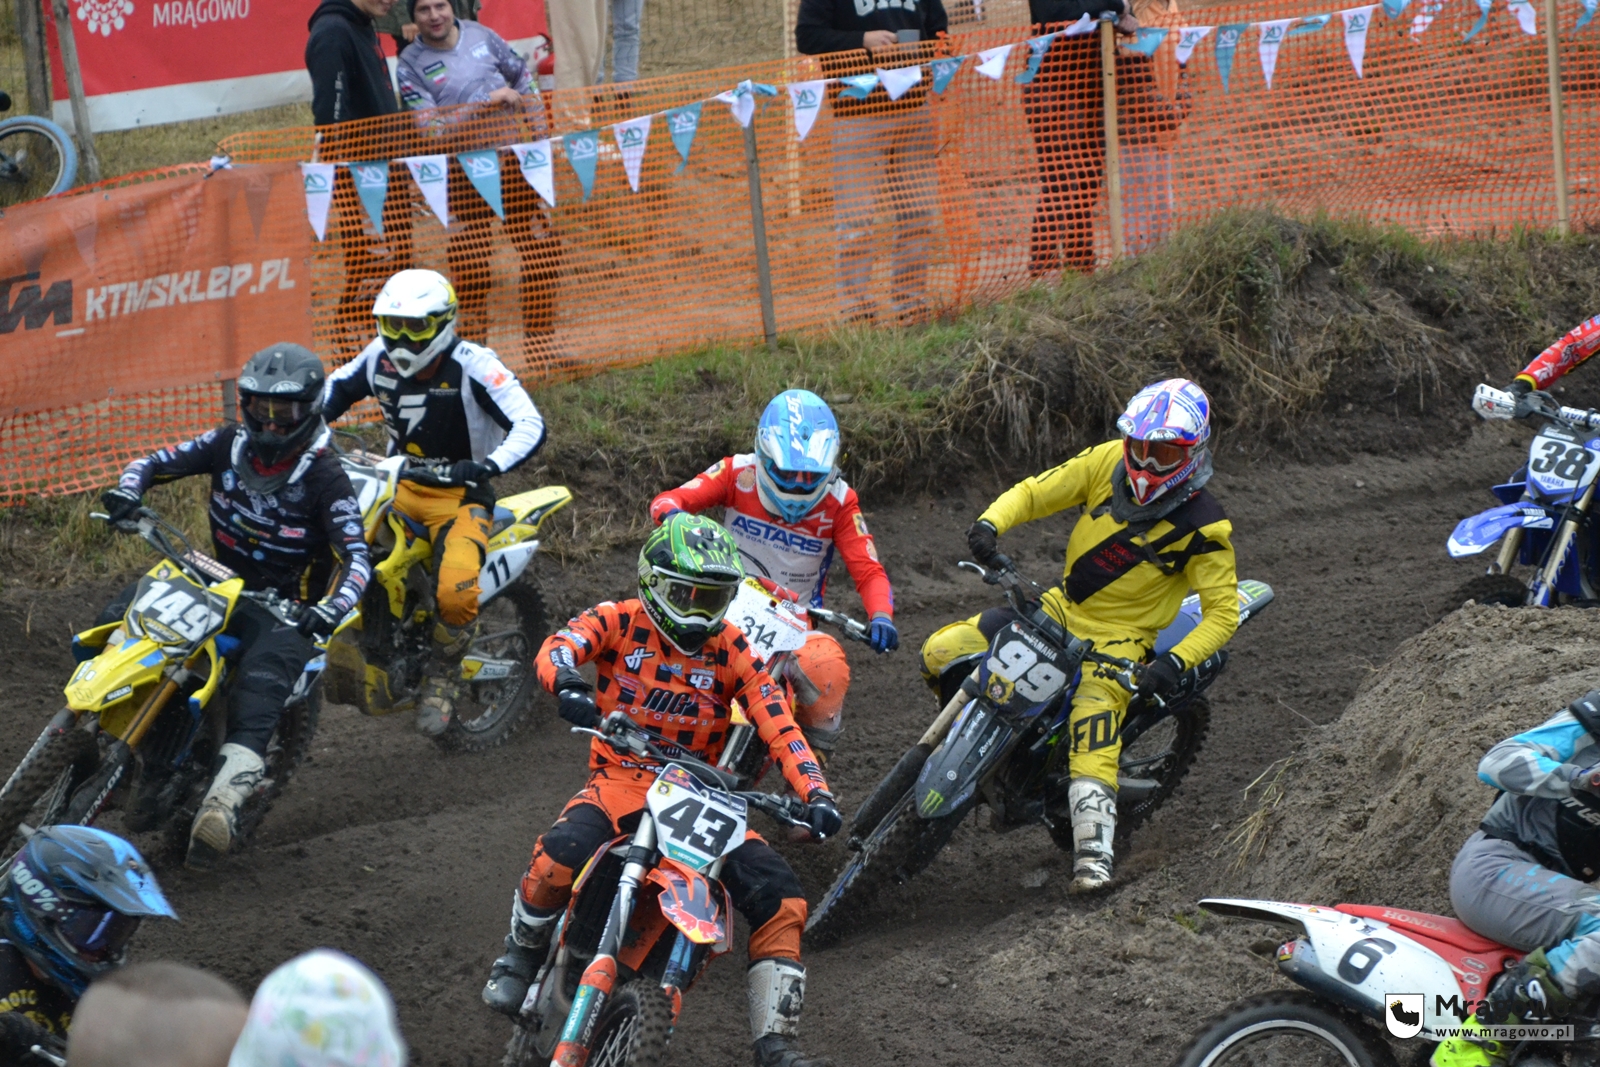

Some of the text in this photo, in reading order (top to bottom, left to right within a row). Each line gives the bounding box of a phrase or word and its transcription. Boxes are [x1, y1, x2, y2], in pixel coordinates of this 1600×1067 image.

[153, 0, 250, 28] MRĄGOWO
[0, 258, 296, 335] TM KTMSKLEP.PL
[1532, 441, 1596, 481] 38
[1541, 475, 1565, 487] YAMAHA
[731, 515, 823, 553] ASTARS
[745, 534, 767, 546] GOAL
[772, 544, 790, 553] ONE
[183, 553, 229, 580] RNTHAL
[487, 553, 511, 588] 11
[133, 581, 223, 641] 149
[742, 616, 777, 650] 314
[1029, 635, 1058, 661] YAMAHA
[690, 675, 714, 690] 43
[987, 641, 1066, 702] 99
[616, 704, 716, 726] MOTORGABI
[1073, 710, 1121, 753] FOX
[657, 797, 738, 858] 43
[11, 861, 60, 911] 100%
[1382, 910, 1448, 934] HONDA
[1338, 937, 1397, 985] 6
[563, 997, 585, 1041] MOTOREX
